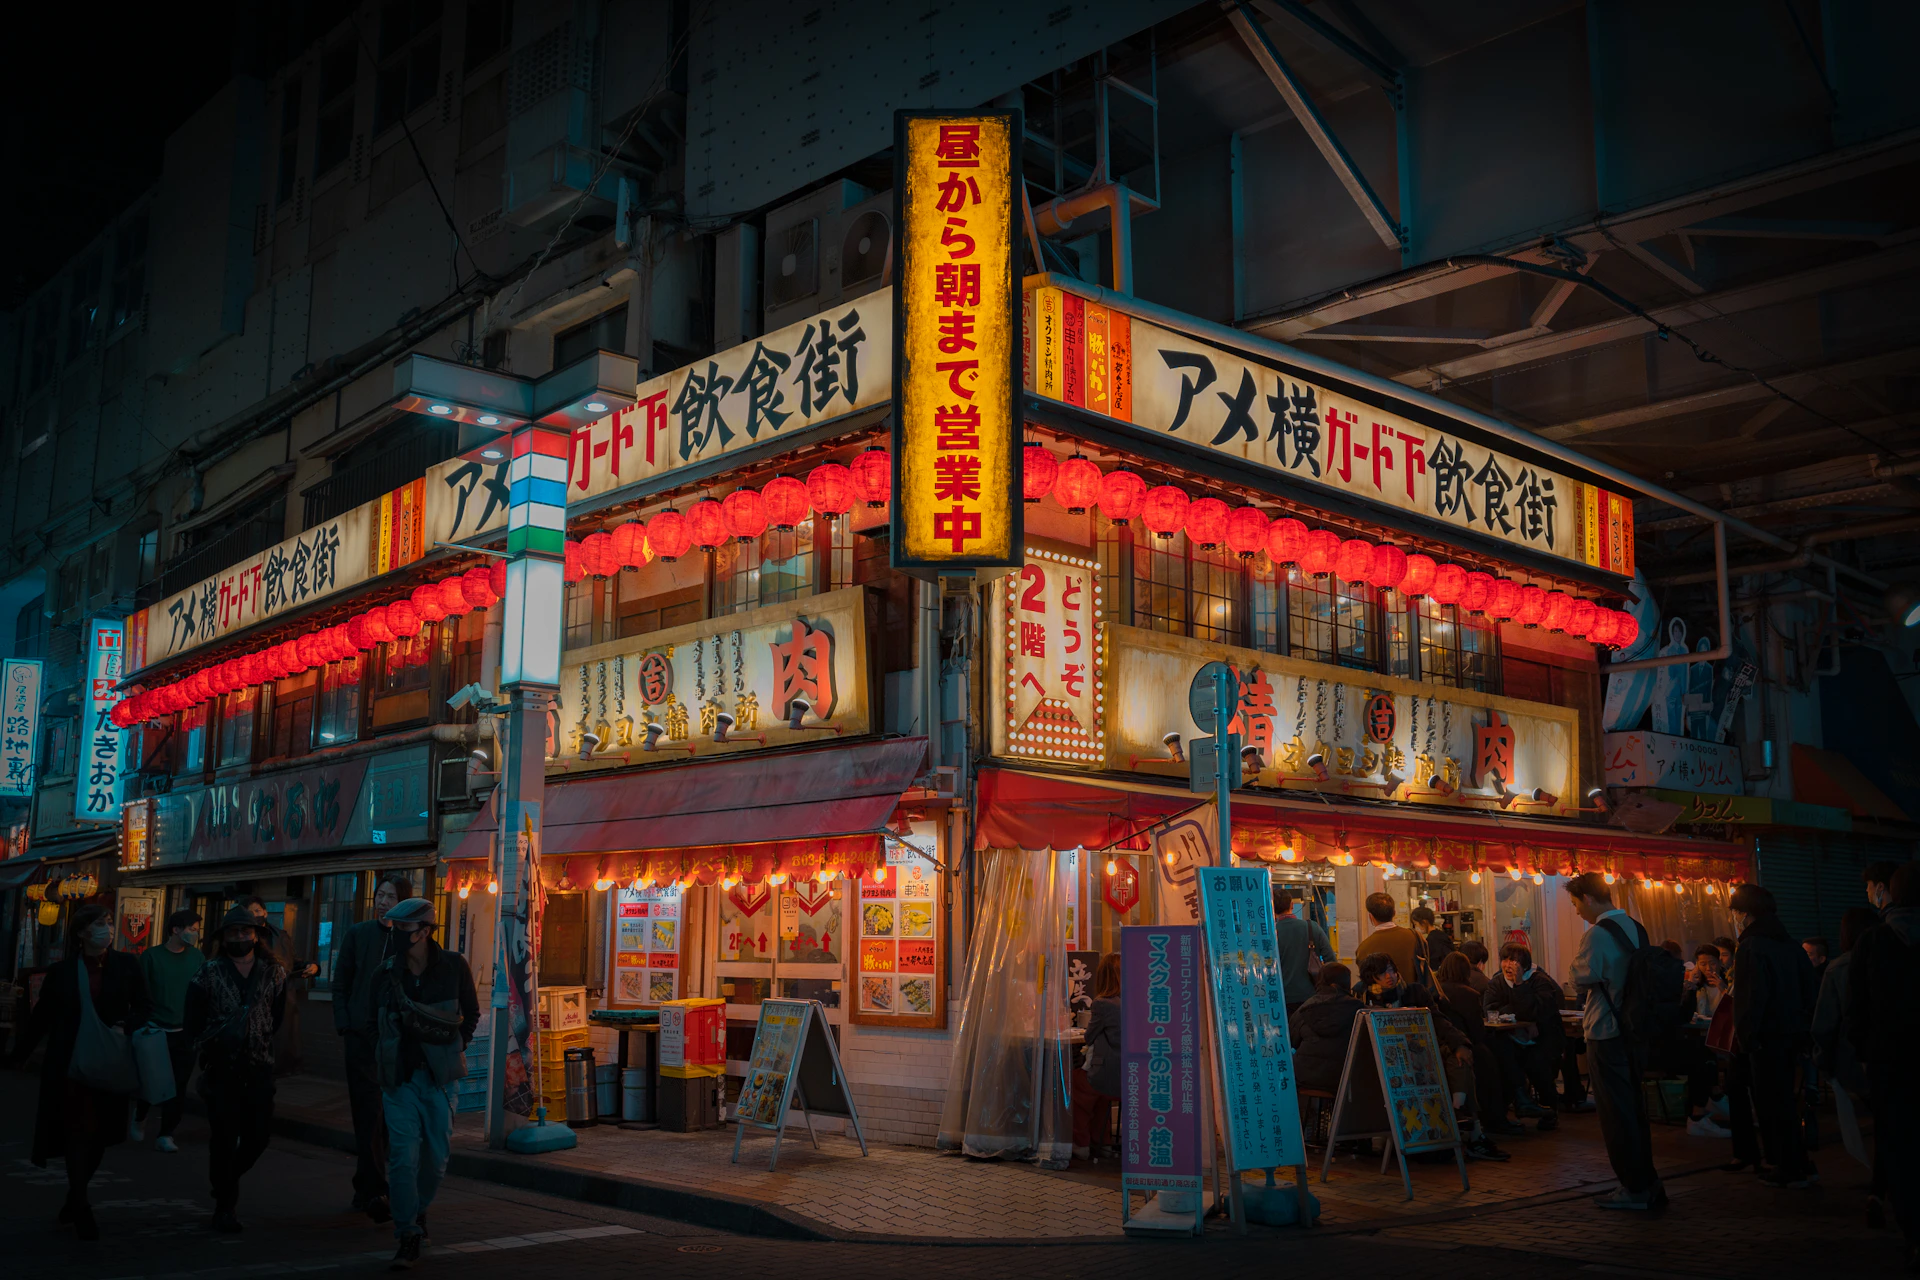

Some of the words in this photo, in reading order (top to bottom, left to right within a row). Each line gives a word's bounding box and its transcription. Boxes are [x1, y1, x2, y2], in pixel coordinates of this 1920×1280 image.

[933, 125, 982, 552] 昼から朝まで営業中
[1045, 315, 1053, 392] オクヨシ精肉所
[1158, 349, 1558, 550] アメ横ガード下飲食街
[167, 523, 340, 656] アメ横ガード下飲食街
[1021, 563, 1046, 697] 2階へ
[1062, 575, 1085, 698] どうぞ
[771, 619, 835, 721] 肉
[5, 715, 30, 780] 路地裏
[87, 708, 120, 813] たきおか
[1475, 710, 1516, 791] 肉
[862, 889, 896, 897] オクヨシ精肉所
[1213, 875, 1259, 892] お願い
[729, 933, 756, 950] 2Fへ
[1147, 933, 1173, 1168] マスク着用・手の消毒・検温
[1180, 934, 1193, 1114] 新型コロナウイルス感染拡大防止策
[1128, 1061, 1139, 1165] 安心安全なお買い物
[1125, 1177, 1198, 1189] 御徒町駅前通り商店会
